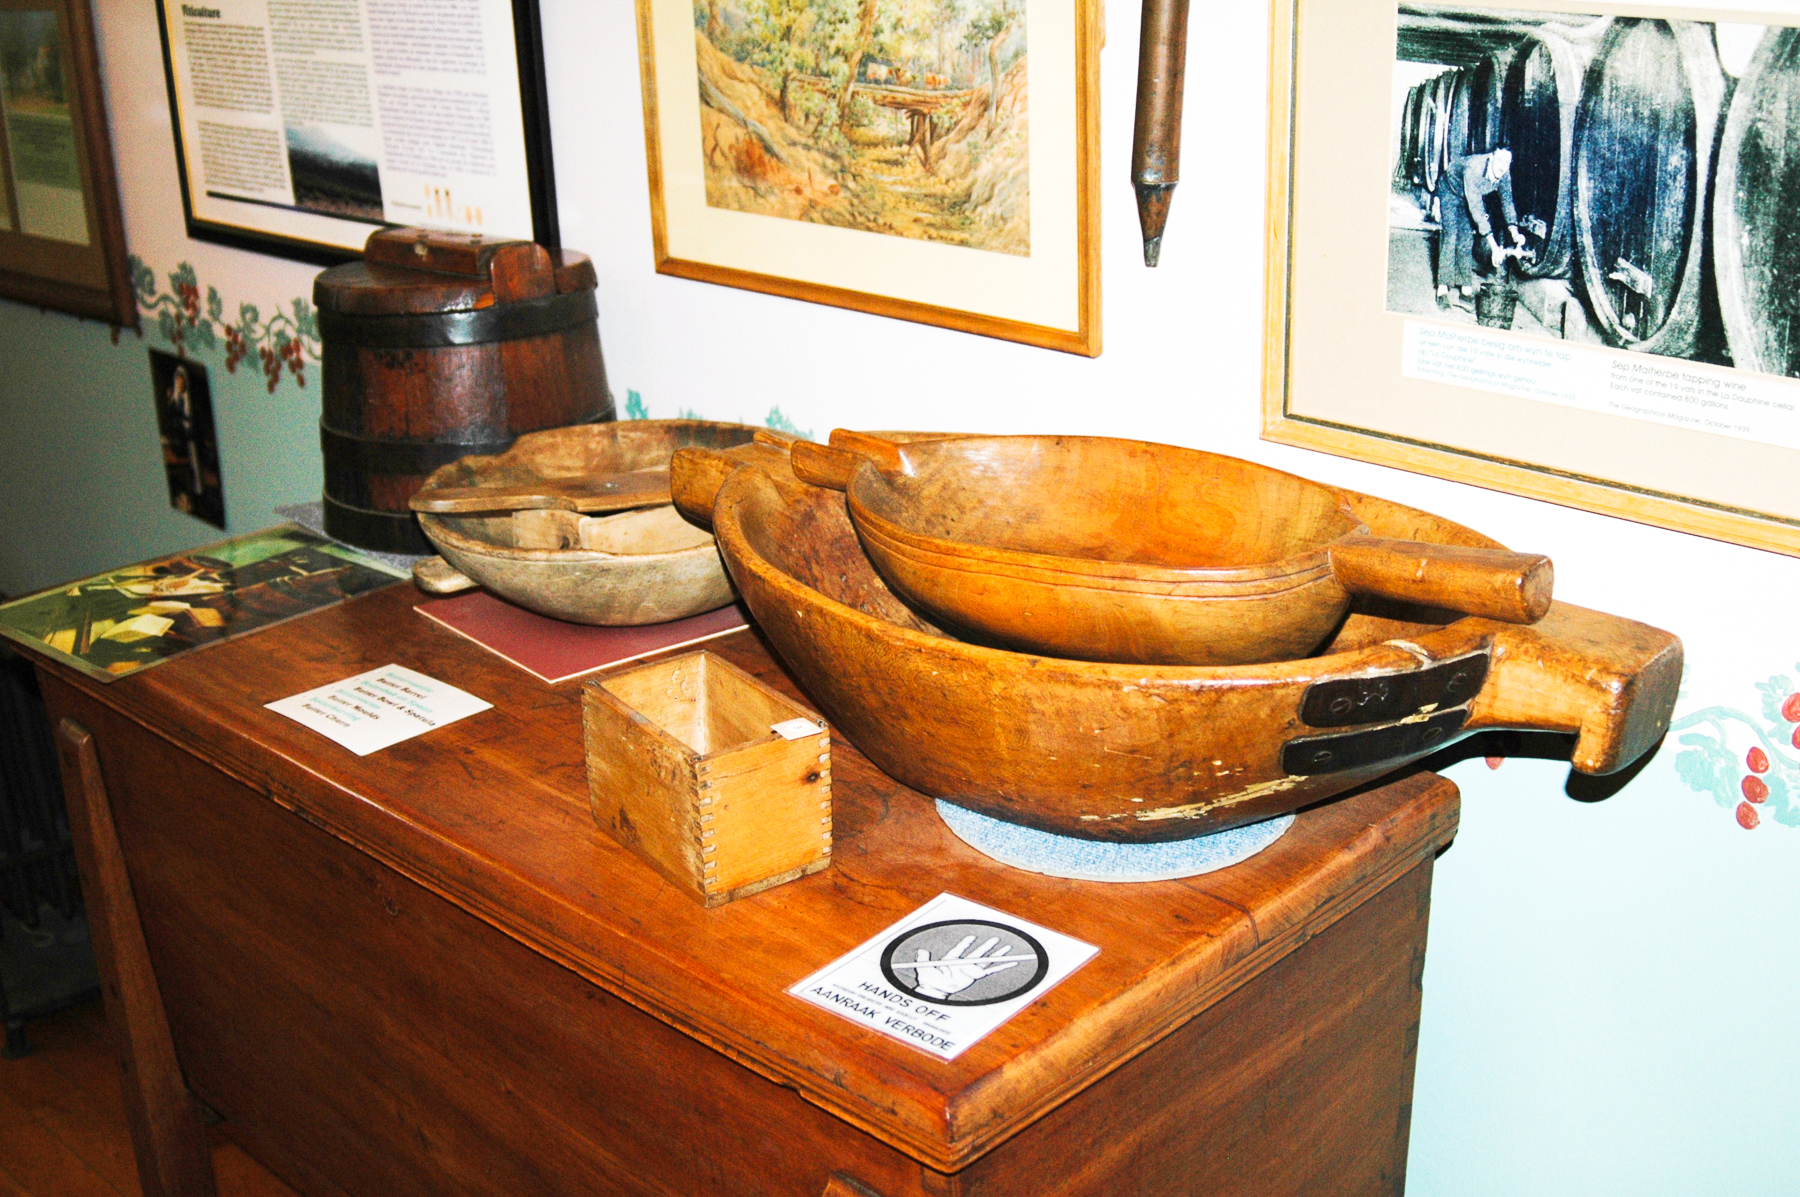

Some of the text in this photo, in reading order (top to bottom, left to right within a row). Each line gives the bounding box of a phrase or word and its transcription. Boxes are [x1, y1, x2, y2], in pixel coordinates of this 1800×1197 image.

[1419, 327, 1572, 361] Sep Malherbe besig om wyn te tap
[1457, 364, 1469, 372] 800
[1612, 360, 1746, 391] Sep Malherbe tapping wine
[1610, 382, 1628, 391] Each
[1644, 389, 1682, 401] contained
[1684, 396, 1699, 404] 800
[1611, 373, 1627, 381] from
[1629, 376, 1644, 384] one
[1670, 382, 1679, 390] 19
[1721, 392, 1730, 400] La
[1732, 394, 1770, 406] Dauphine
[1621, 404, 1666, 416] Geographical
[1704, 419, 1731, 429] October
[1734, 424, 1751, 432] 1939
[859, 981, 952, 1022] HANDS OFF
[811, 987, 955, 1050] AANRAAK VERBODE
